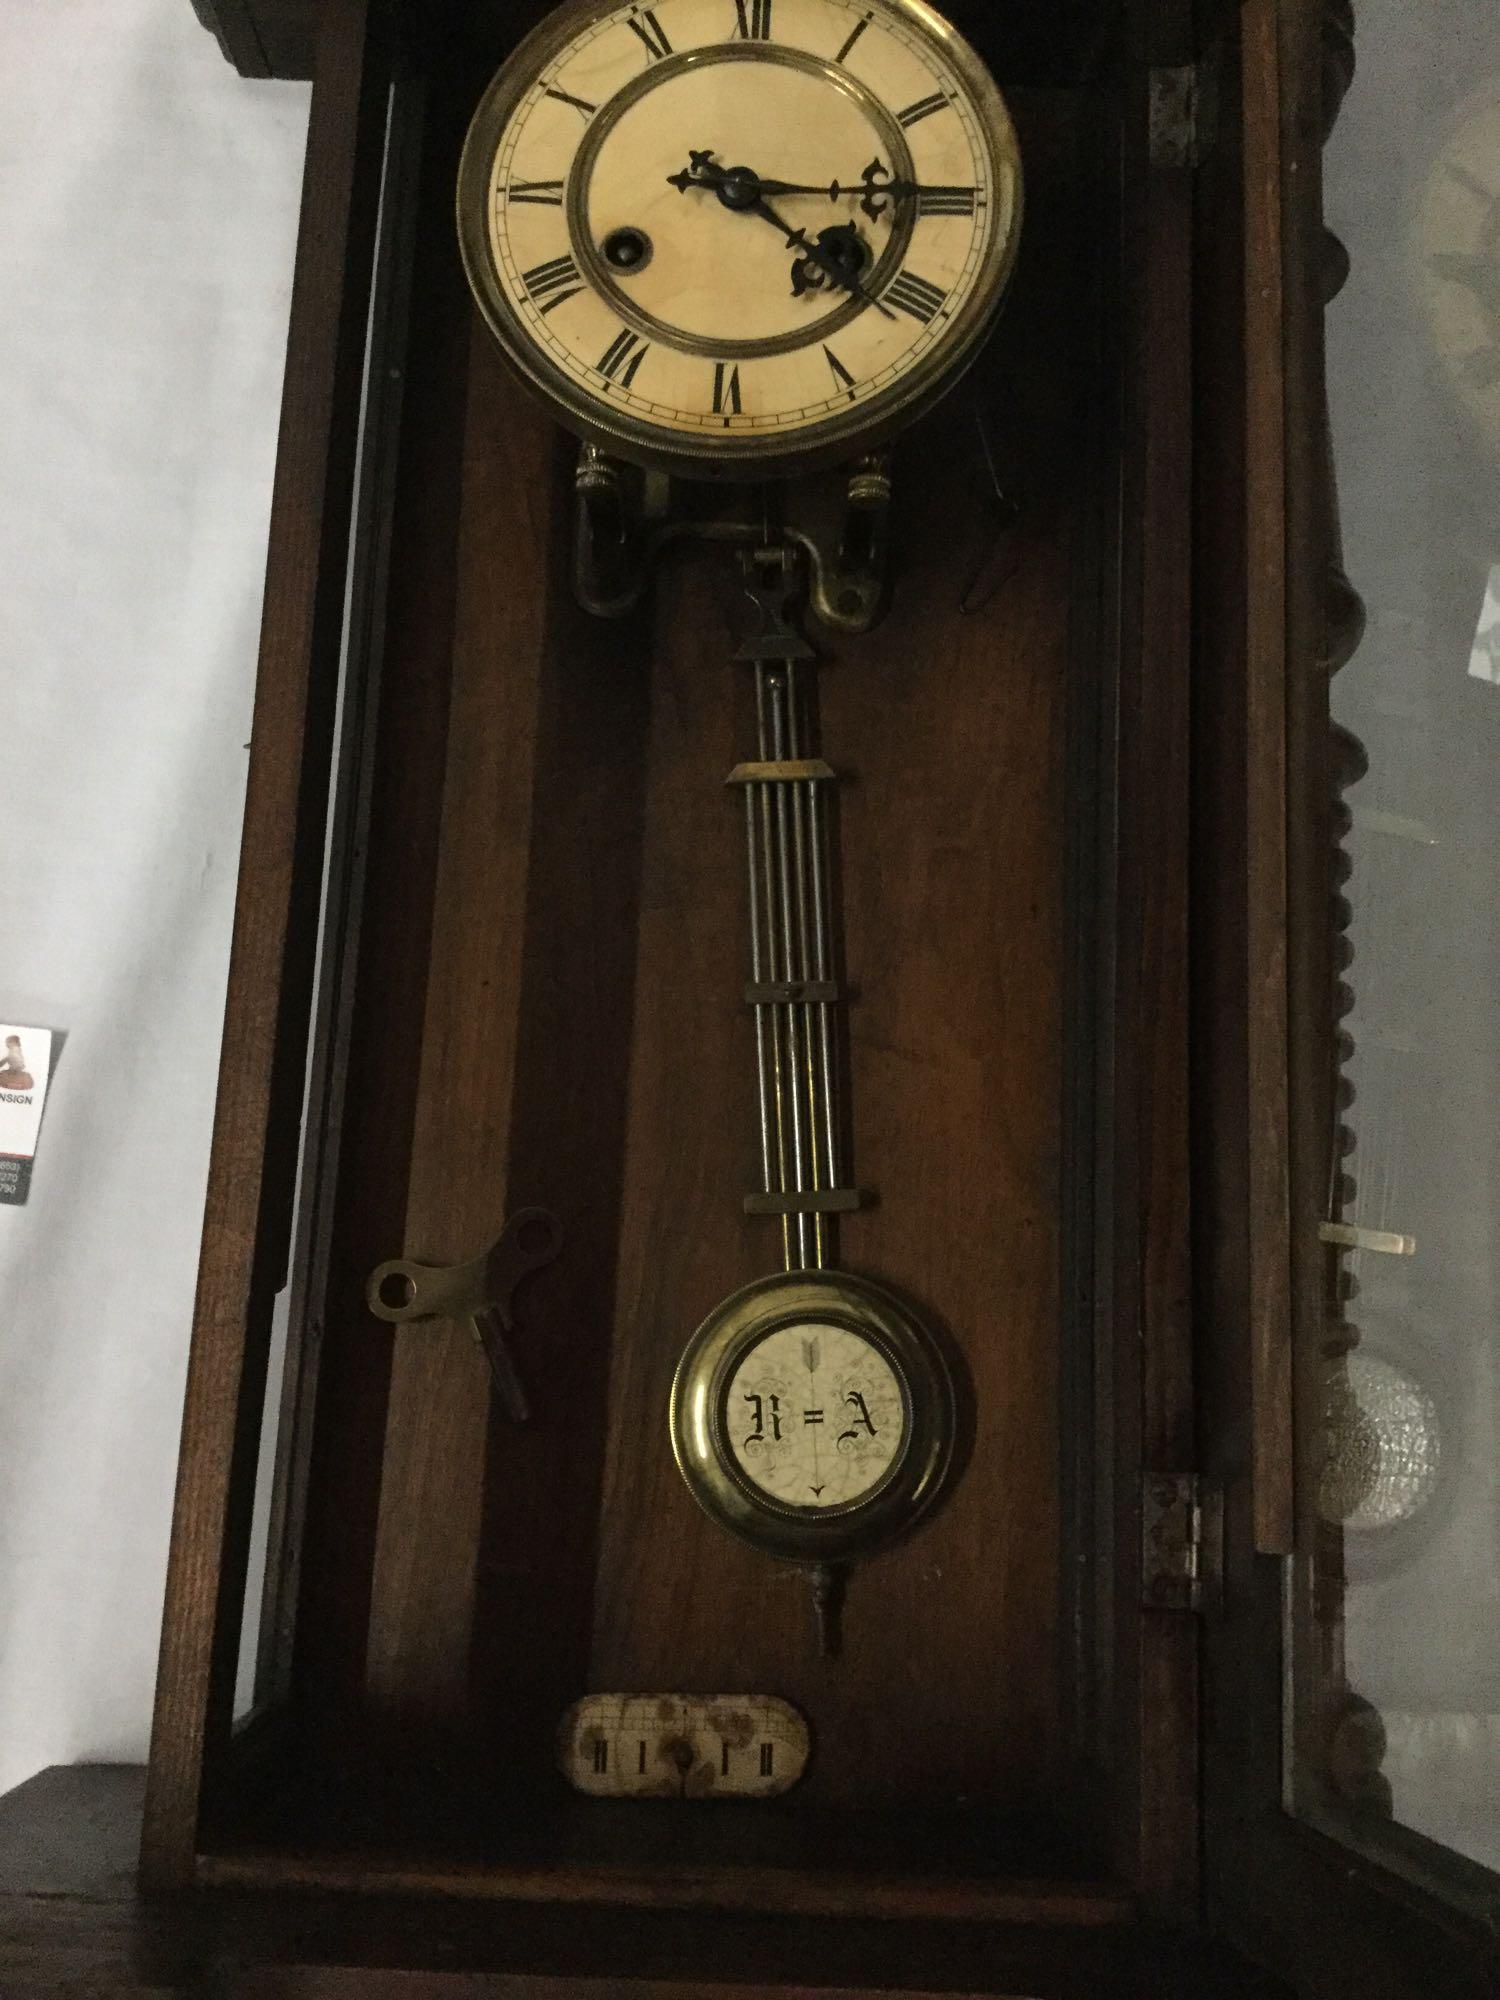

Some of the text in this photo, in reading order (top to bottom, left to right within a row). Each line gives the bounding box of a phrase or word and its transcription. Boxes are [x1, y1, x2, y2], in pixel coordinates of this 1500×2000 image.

[626, 10, 675, 64] XI
[897, 91, 951, 131] II
[508, 173, 566, 207] IX
[522, 254, 588, 317] VIII
[596, 327, 652, 391] VII
[711, 361, 744, 416] VI
